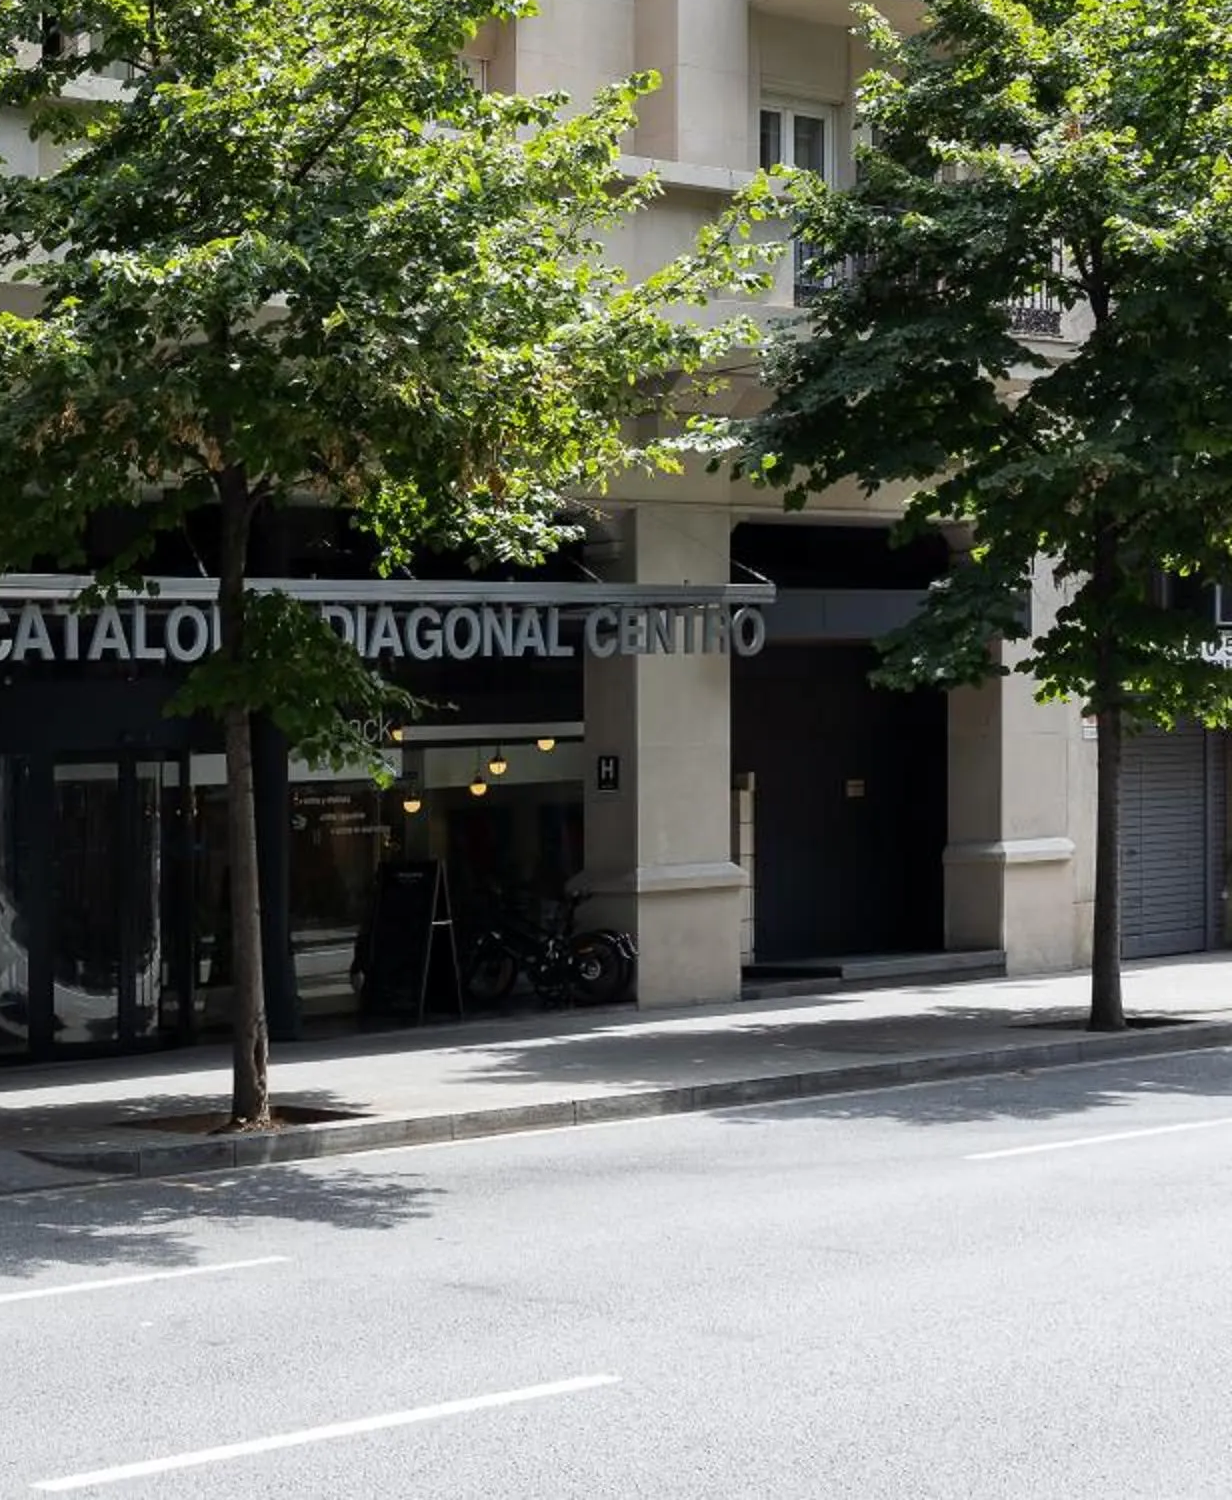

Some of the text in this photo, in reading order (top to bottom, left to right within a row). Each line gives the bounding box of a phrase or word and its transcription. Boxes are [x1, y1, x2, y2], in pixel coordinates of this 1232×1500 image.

[322, 605, 574, 660] DIAGONAL
[585, 606, 766, 658] CENTRO
[601, 758, 614, 780] H
